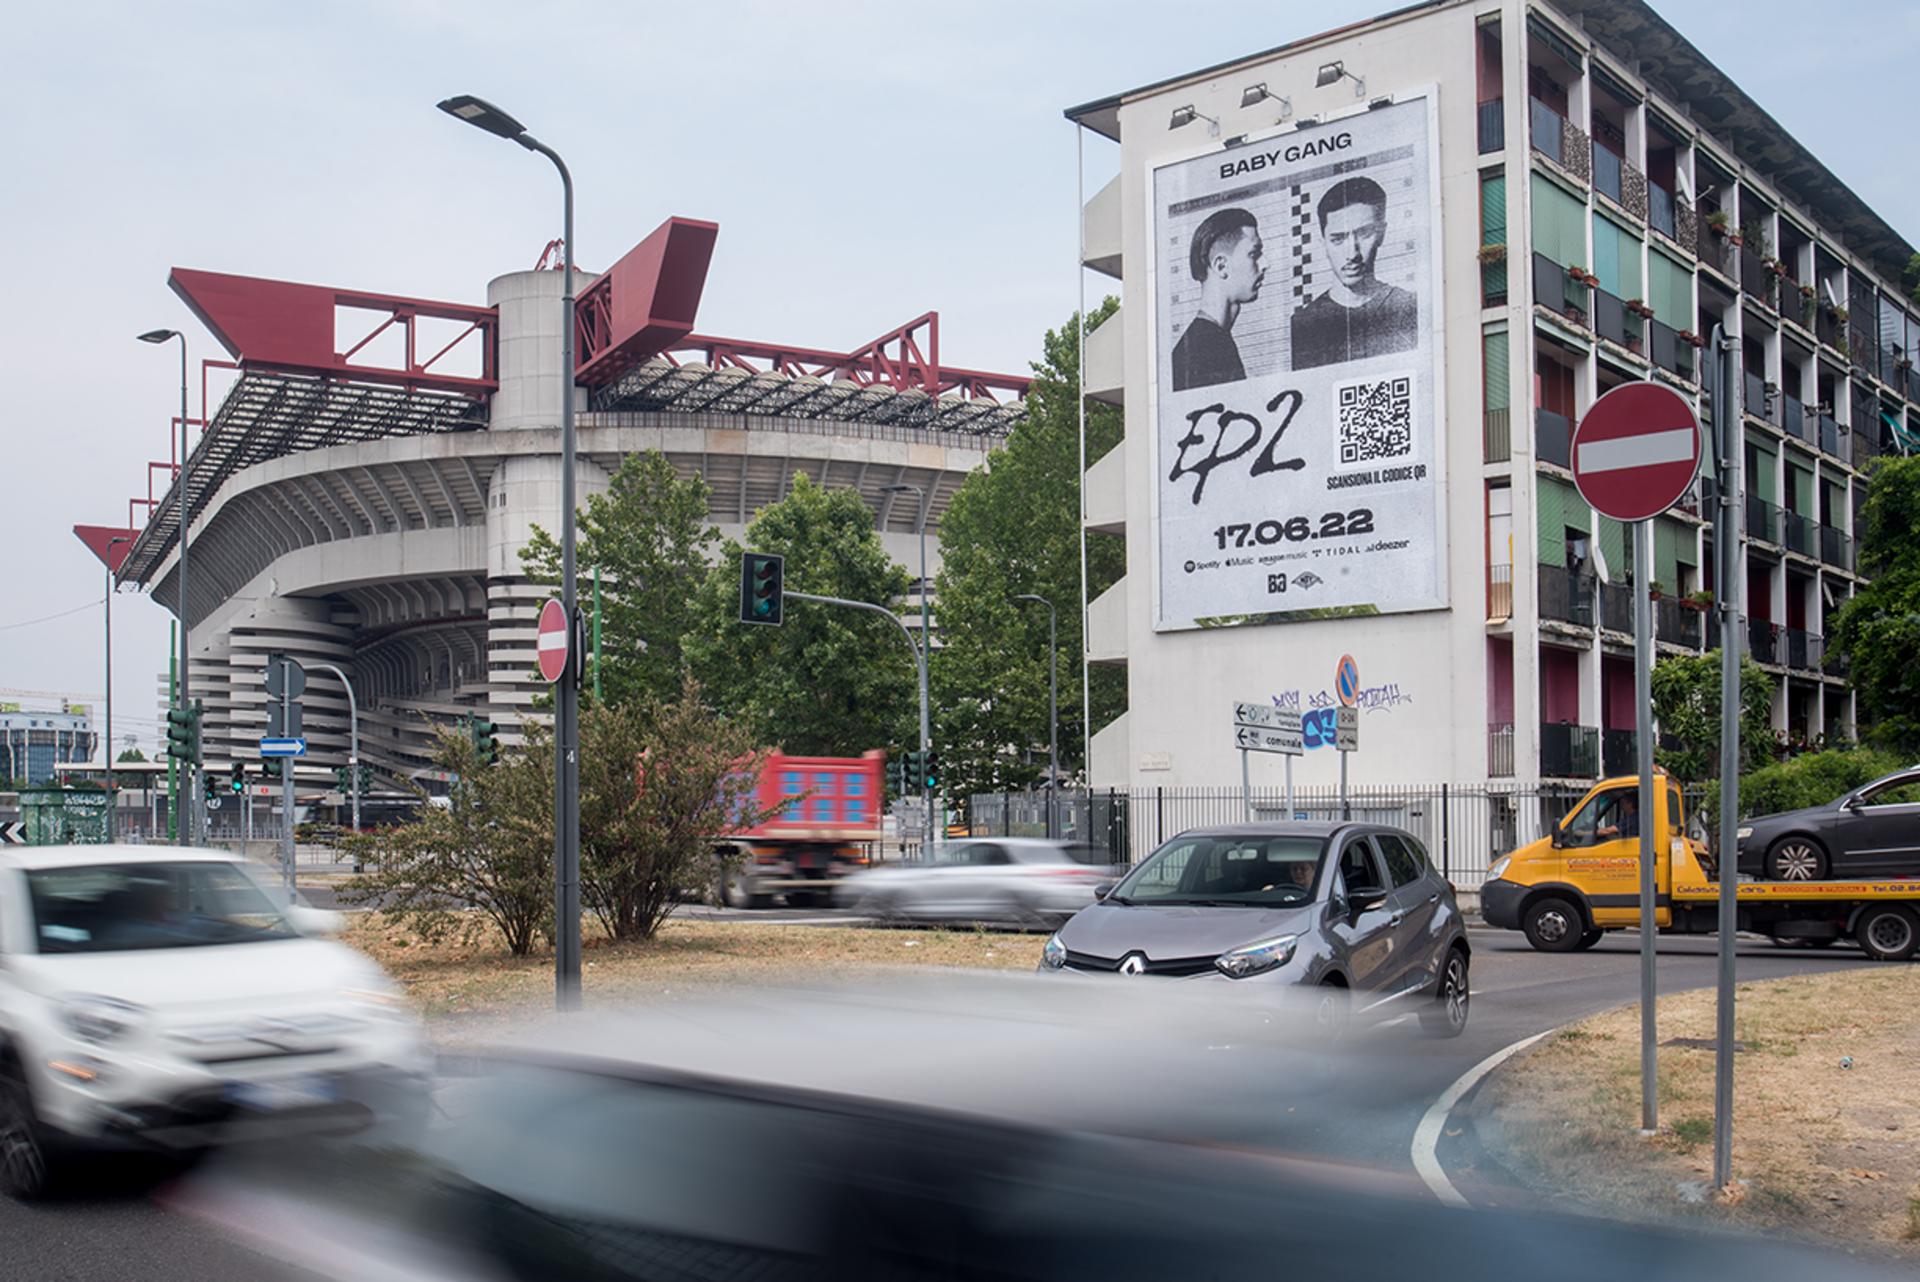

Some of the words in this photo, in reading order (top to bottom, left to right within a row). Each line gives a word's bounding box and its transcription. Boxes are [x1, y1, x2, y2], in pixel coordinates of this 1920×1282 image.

[1220, 150, 1280, 179] BABY
[1285, 132, 1352, 162] GANG
[1327, 472, 1372, 490] SCANSIONA
[1374, 471, 1381, 484] IL
[1382, 466, 1413, 483] CODICE
[1414, 464, 1426, 480] QR
[1214, 509, 1374, 549] 17.06.22
[1231, 557, 1254, 566] Music
[1326, 545, 1360, 556] TIDAL
[1375, 540, 1410, 551] deezer
